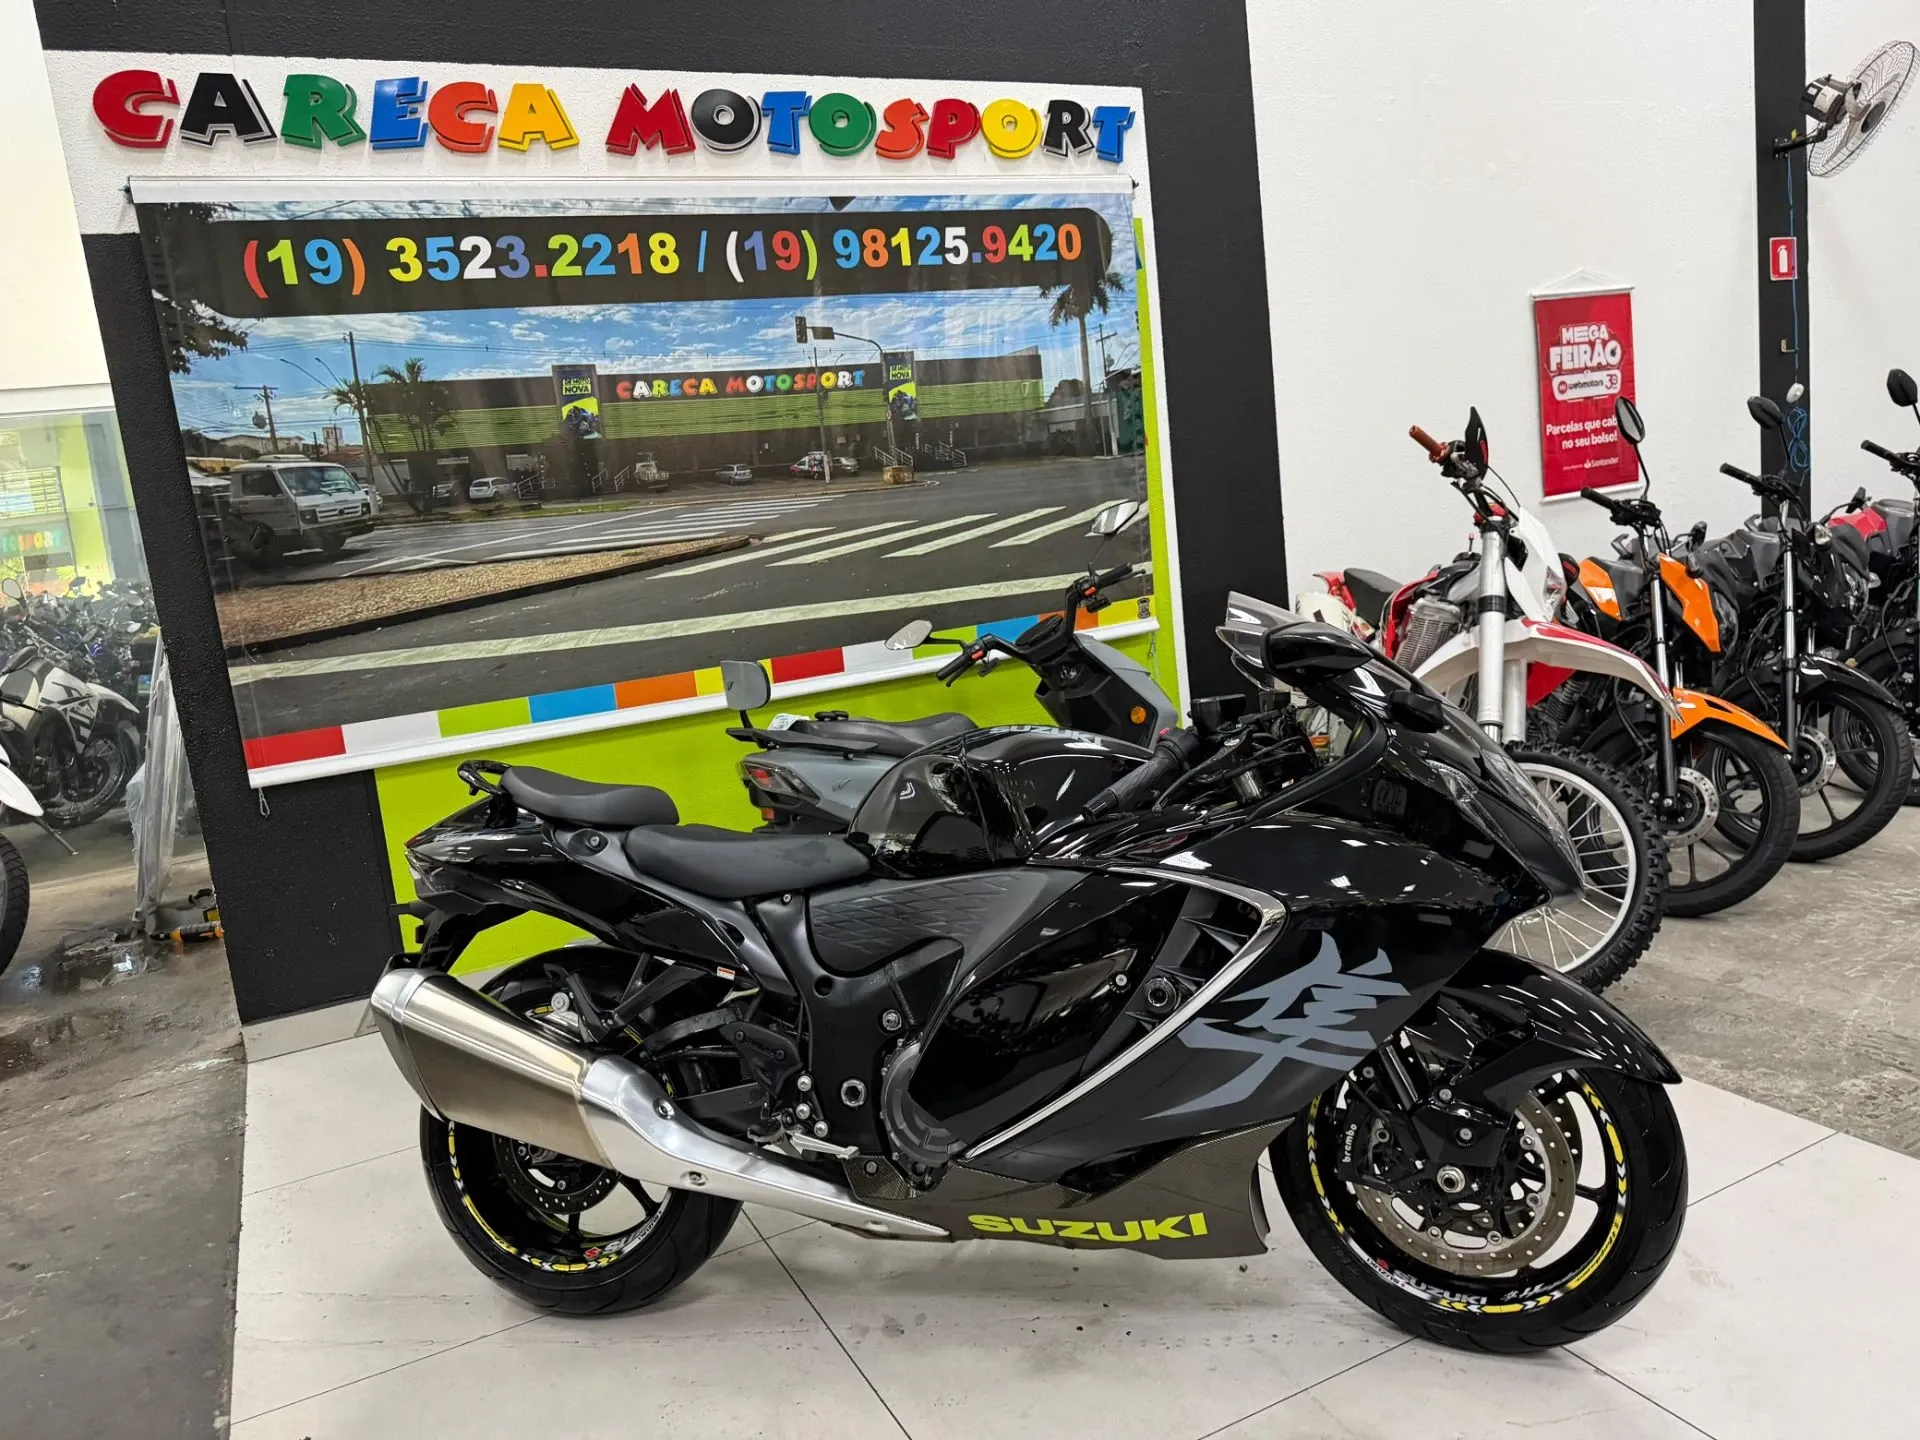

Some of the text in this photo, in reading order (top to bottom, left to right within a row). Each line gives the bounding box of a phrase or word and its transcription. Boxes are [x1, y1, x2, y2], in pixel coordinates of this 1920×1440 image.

[93, 69, 1135, 163] CARECA MOTOSPORT
[244, 238, 366, 299] (19)
[385, 232, 679, 282] 3523.2218
[726, 229, 818, 283] (19)
[832, 224, 1081, 269] 98125.9420
[1561, 324, 1609, 345] MEGA
[1549, 339, 1621, 371] FEIRÃO
[564, 385, 590, 394] NOVA
[616, 368, 865, 399] CARECA MOTOSPORT
[1546, 415, 1618, 436] Parcelas que cab
[1562, 430, 1618, 449] no seu bolso!
[989, 725, 1102, 747] SUZUKI
[1342, 1123, 1357, 1163] brembo
[967, 1212, 1208, 1242] SUZUKI
[1393, 1269, 1487, 1305] SUZUKI
